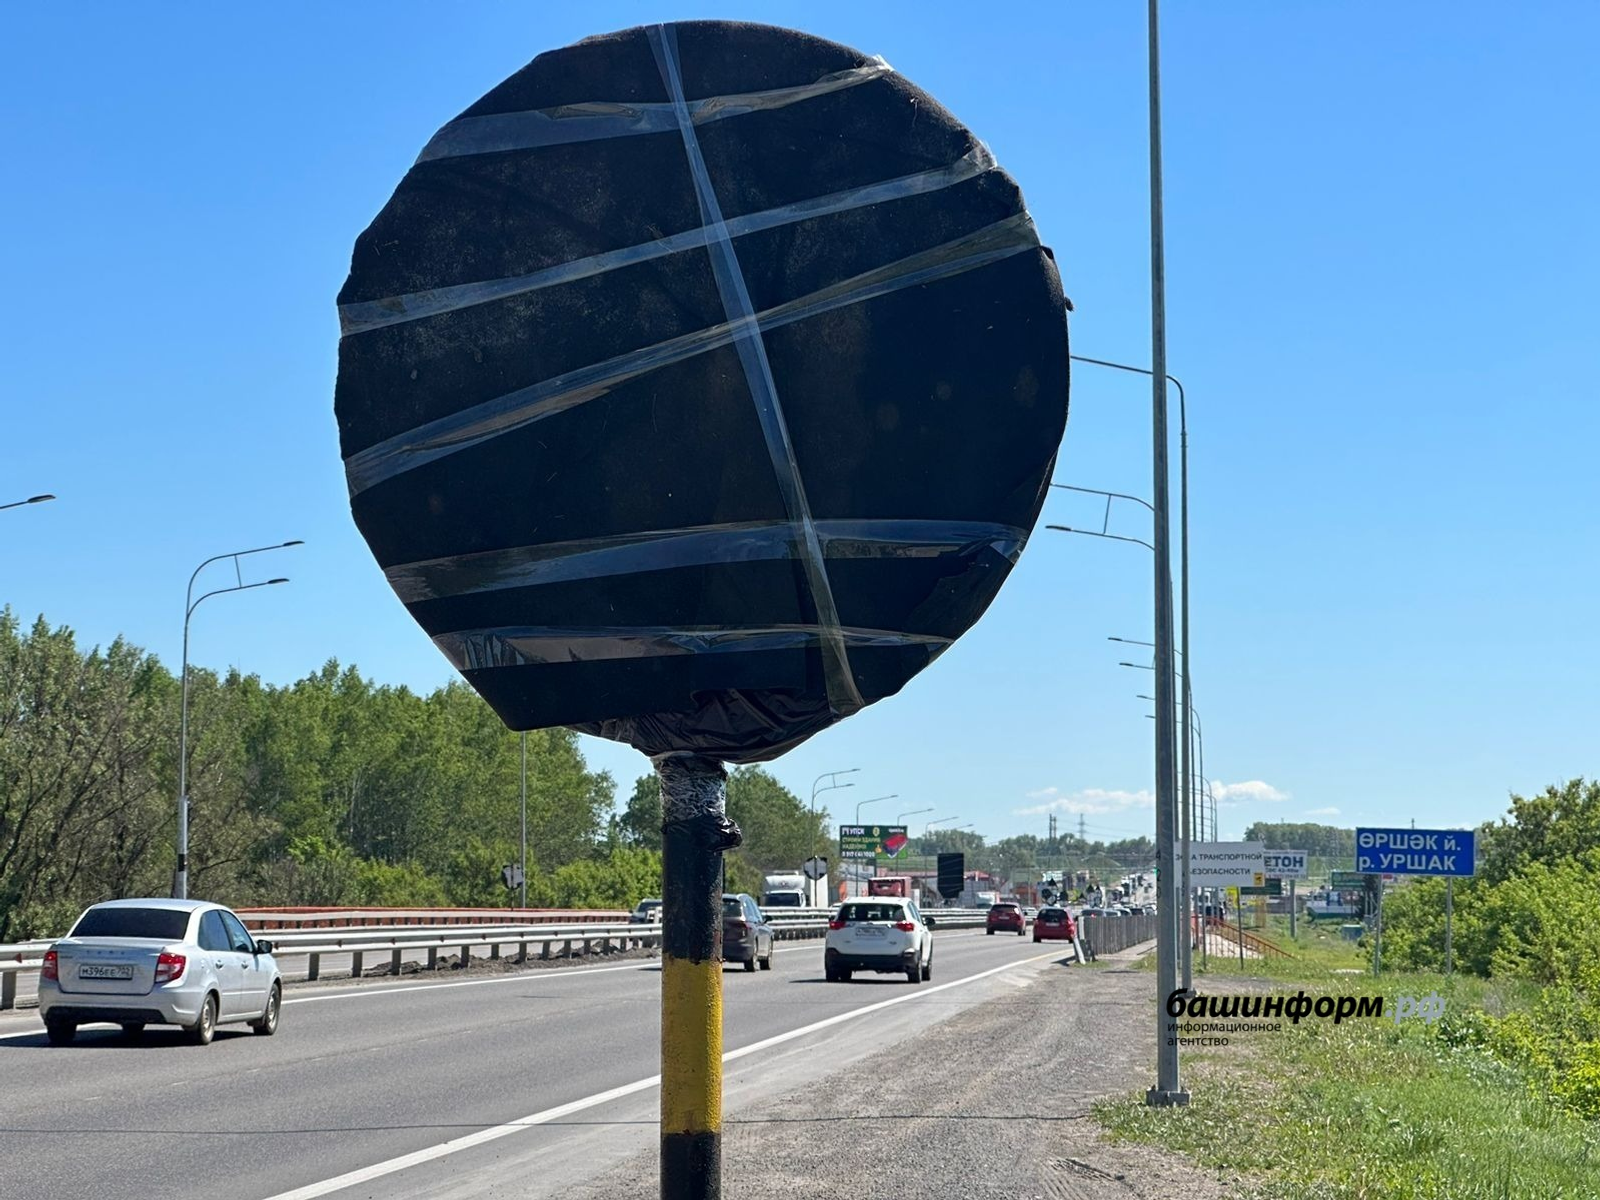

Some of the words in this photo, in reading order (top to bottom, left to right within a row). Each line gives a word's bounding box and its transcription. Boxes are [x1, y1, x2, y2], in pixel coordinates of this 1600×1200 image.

[1358, 832, 1438, 850] ӨРШӘК
[1444, 835, 1461, 851] й.
[1175, 853, 1198, 861] ЗА
[1200, 852, 1262, 861] ТРАНСПОРТНОЙ
[1264, 856, 1304, 868] ЕТОН
[1358, 855, 1375, 872] р.
[1379, 852, 1456, 871] УРШАК
[1190, 867, 1251, 875] ЕЗОПАСНОСТИ
